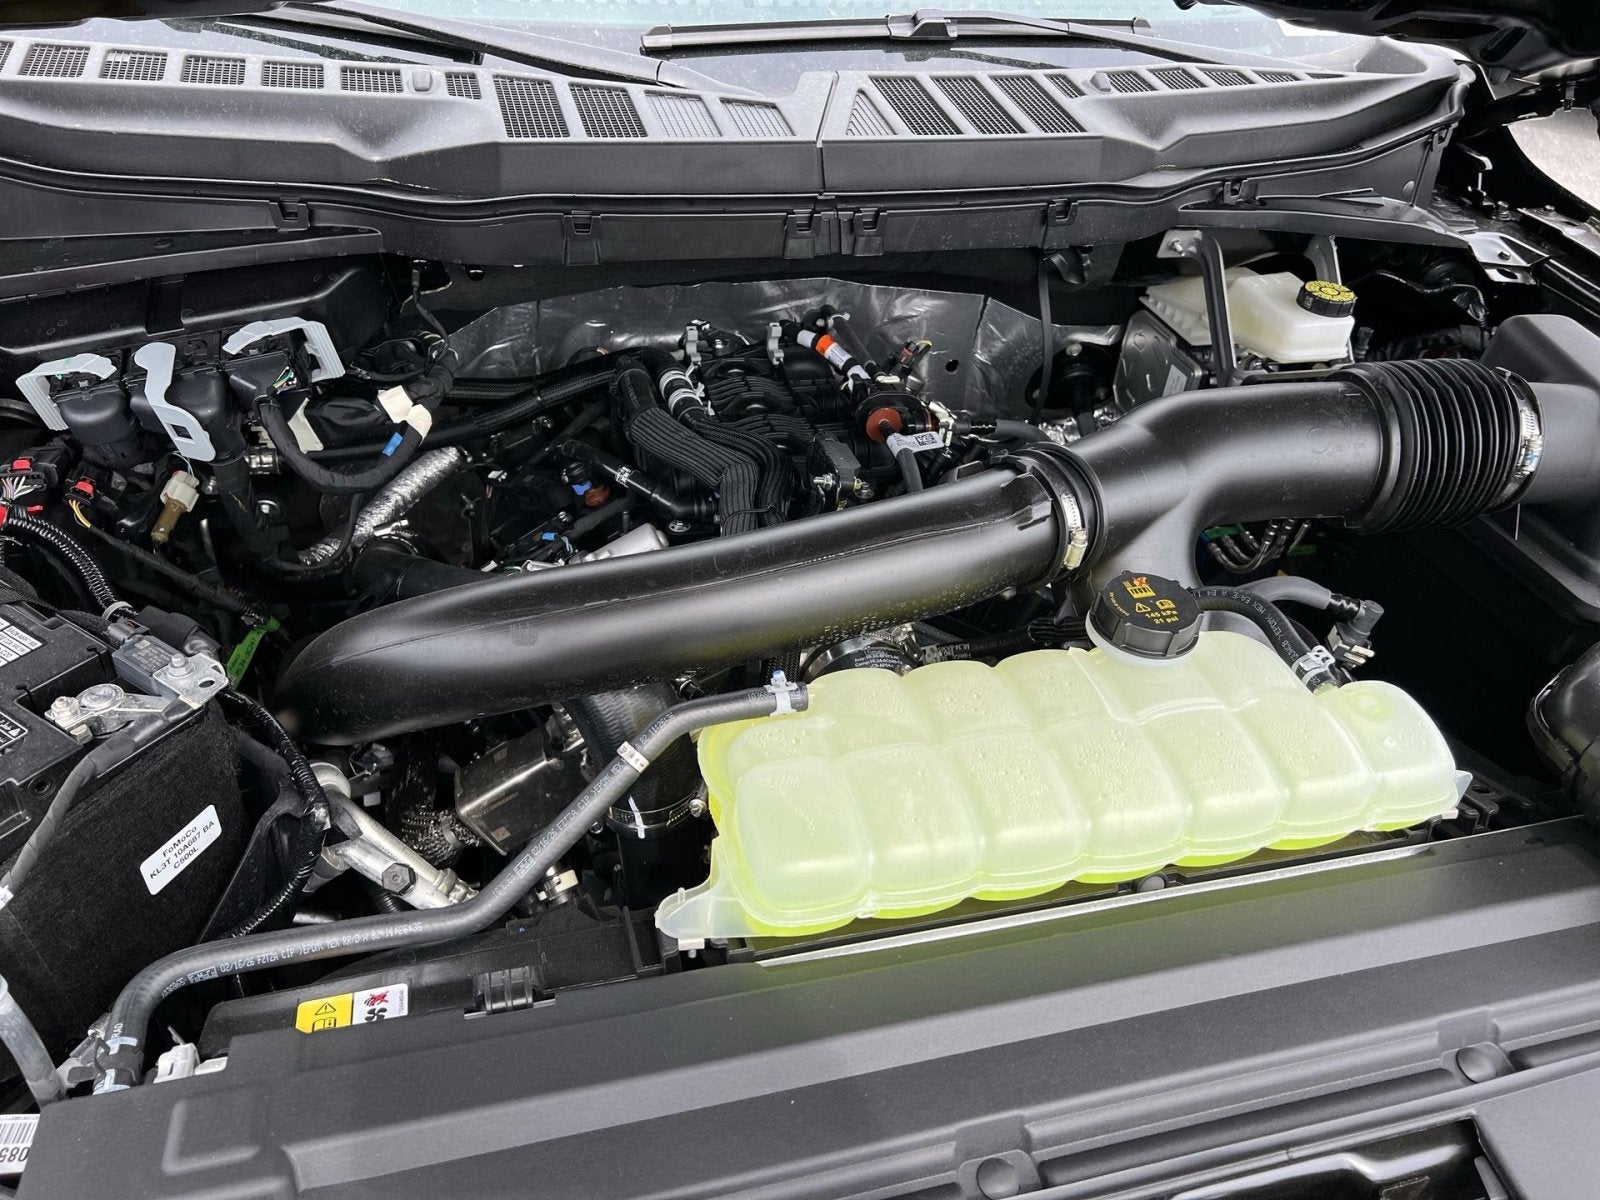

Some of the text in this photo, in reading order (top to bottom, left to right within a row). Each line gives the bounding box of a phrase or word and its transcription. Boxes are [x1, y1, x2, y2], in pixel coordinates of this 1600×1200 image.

[149, 820, 215, 879] KL3T 10A687 BA
[162, 826, 197, 857] FoMoCo
[173, 846, 199, 869] C500L
[281, 947, 294, 959] CIP
